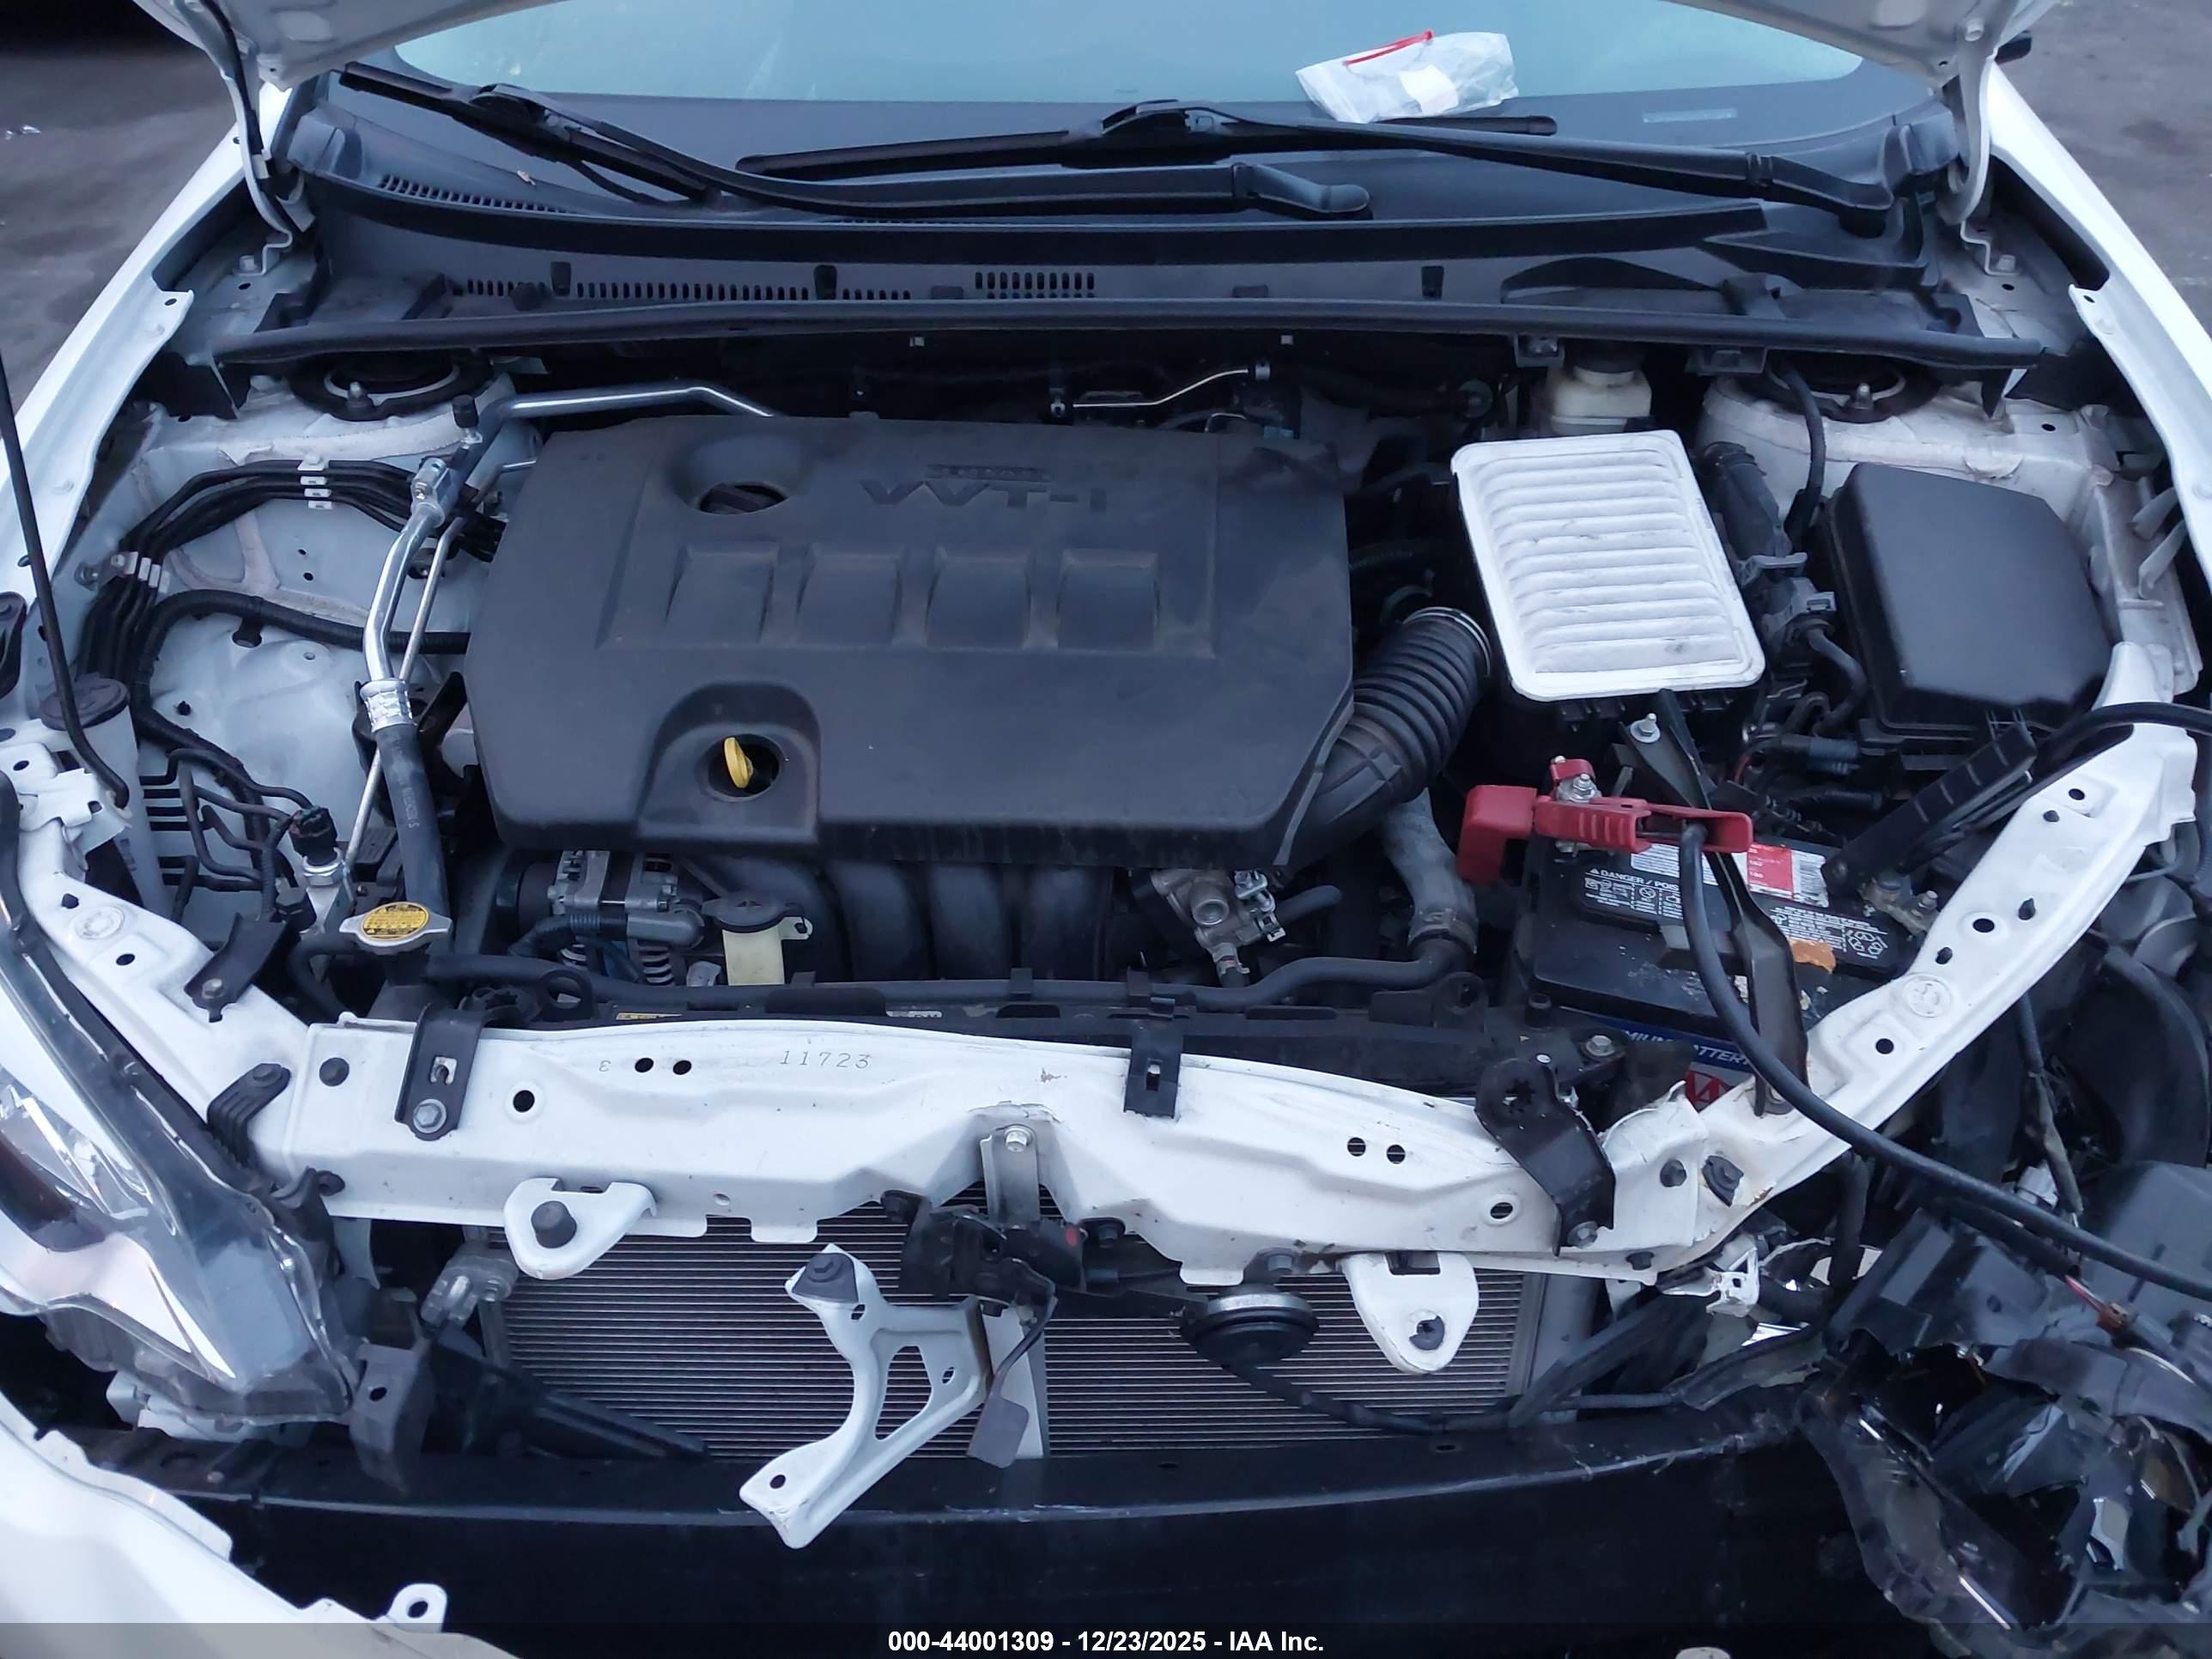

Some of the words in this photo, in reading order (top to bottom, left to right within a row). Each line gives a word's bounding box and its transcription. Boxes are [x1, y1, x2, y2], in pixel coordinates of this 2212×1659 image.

[1600, 869, 1644, 884] DANGER
[1654, 880, 1680, 891] POIS
[779, 1049, 871, 1070] 11723
